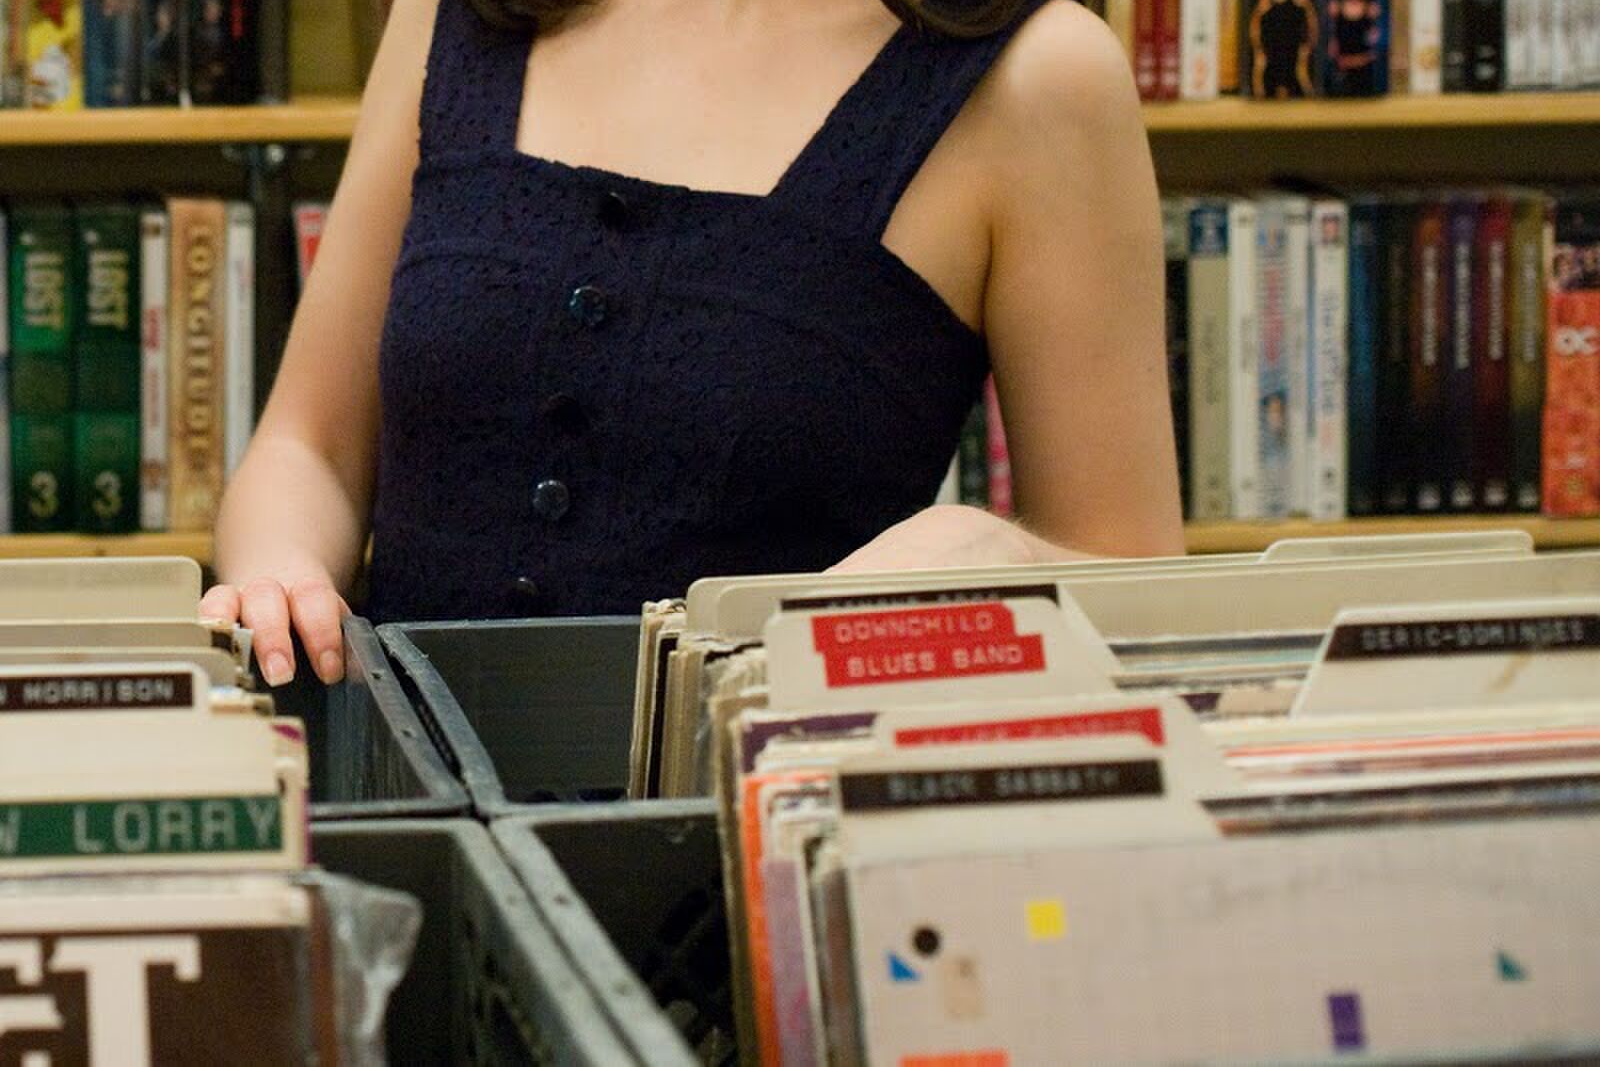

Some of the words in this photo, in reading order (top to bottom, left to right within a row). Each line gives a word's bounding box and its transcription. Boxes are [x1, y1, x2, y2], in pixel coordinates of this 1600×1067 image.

[30, 471, 59, 519] 3
[94, 470, 123, 519] 3
[846, 651, 936, 679] BLUES
[952, 644, 1024, 670] BAND
[22, 677, 175, 706] MORRISON
[72, 797, 282, 855] LORRY
